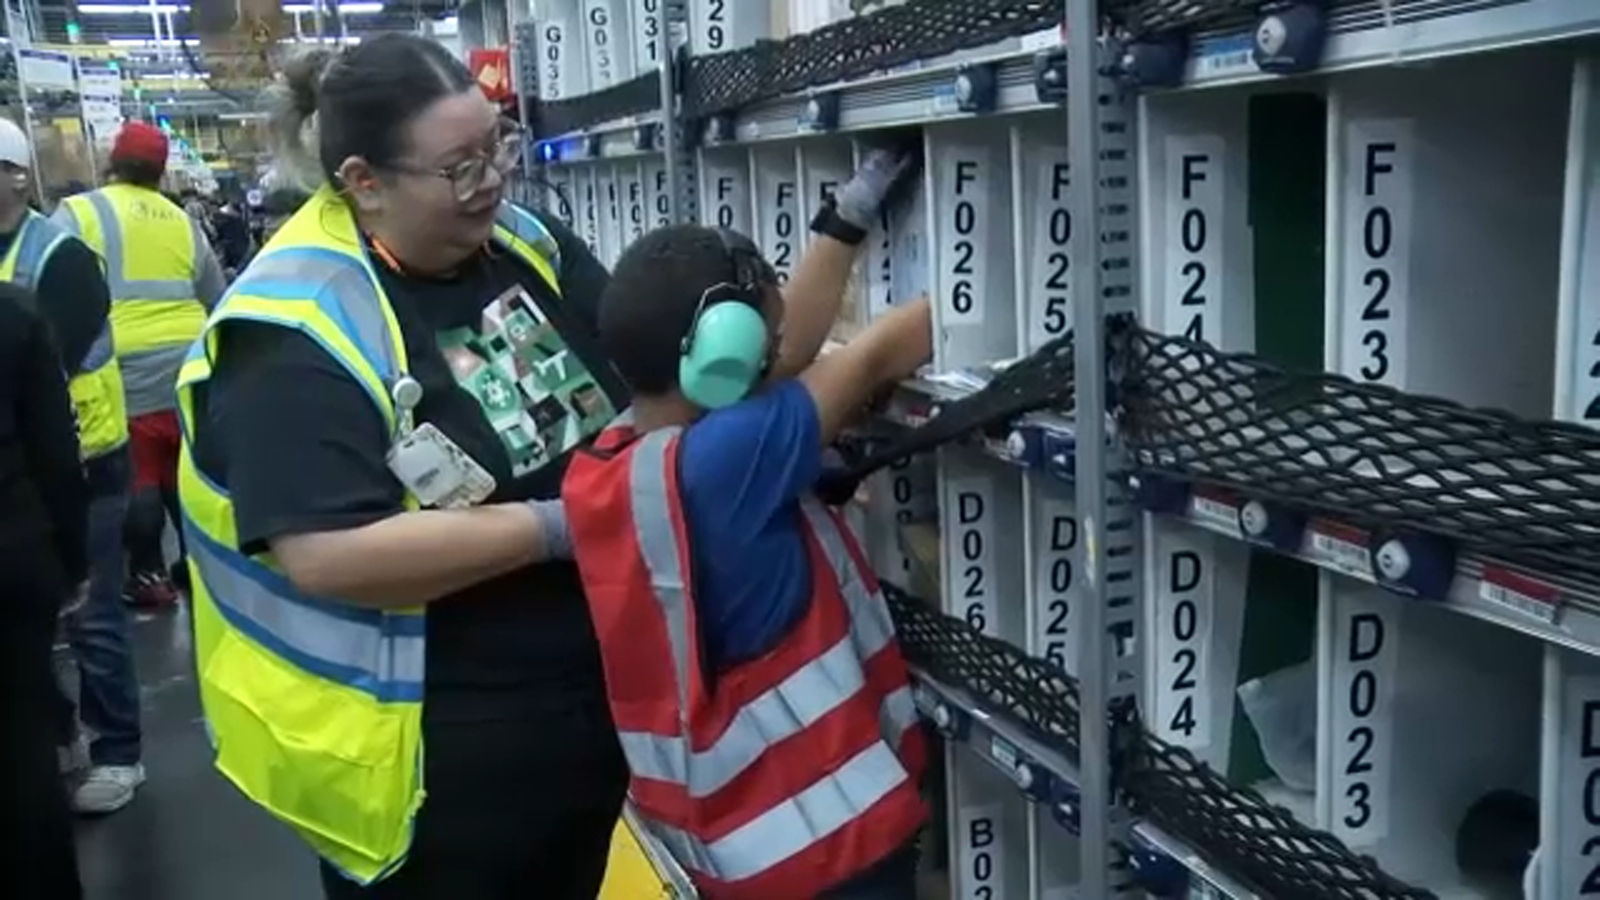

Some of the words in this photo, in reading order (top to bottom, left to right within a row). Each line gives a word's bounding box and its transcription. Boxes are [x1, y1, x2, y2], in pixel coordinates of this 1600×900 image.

[952, 161, 978, 313] F026
[1044, 163, 1072, 334] F025
[1361, 143, 1396, 381] F023
[958, 492, 985, 633] D026
[1046, 516, 1077, 668] D025
[1170, 550, 1201, 736] D024
[1344, 613, 1384, 828] D023
